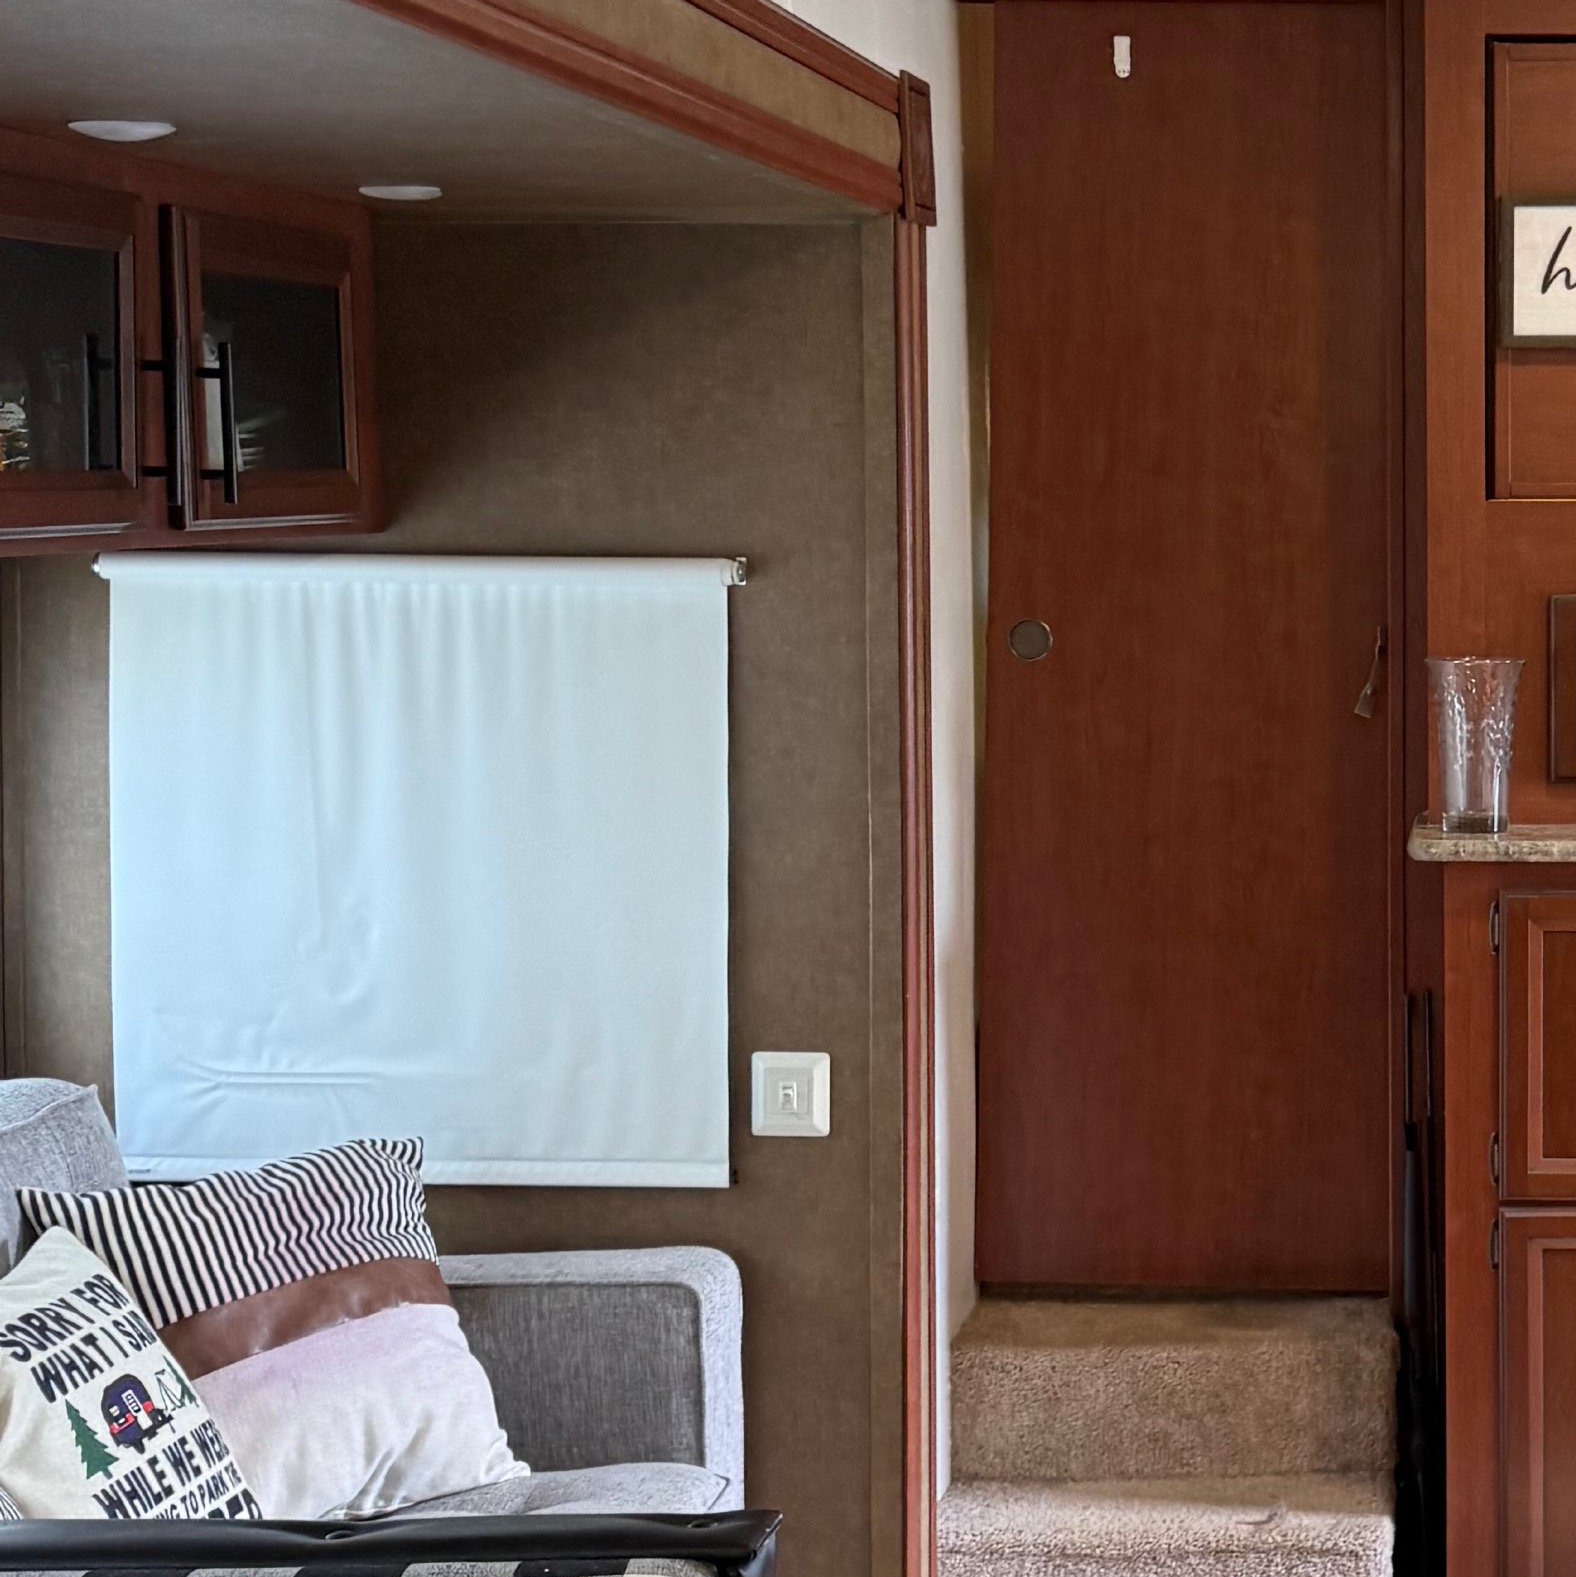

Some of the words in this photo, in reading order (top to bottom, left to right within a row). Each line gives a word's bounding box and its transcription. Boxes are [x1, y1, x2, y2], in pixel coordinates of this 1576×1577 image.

[0, 1297, 95, 1362] SORRY
[70, 1273, 130, 1317] FOR
[30, 1332, 115, 1404] WHAT
[98, 1326, 130, 1359] I
[91, 1455, 175, 1519] WHILE
[162, 1435, 203, 1488] WE
[179, 1489, 199, 1519] TO
[199, 1473, 230, 1510] PARK
